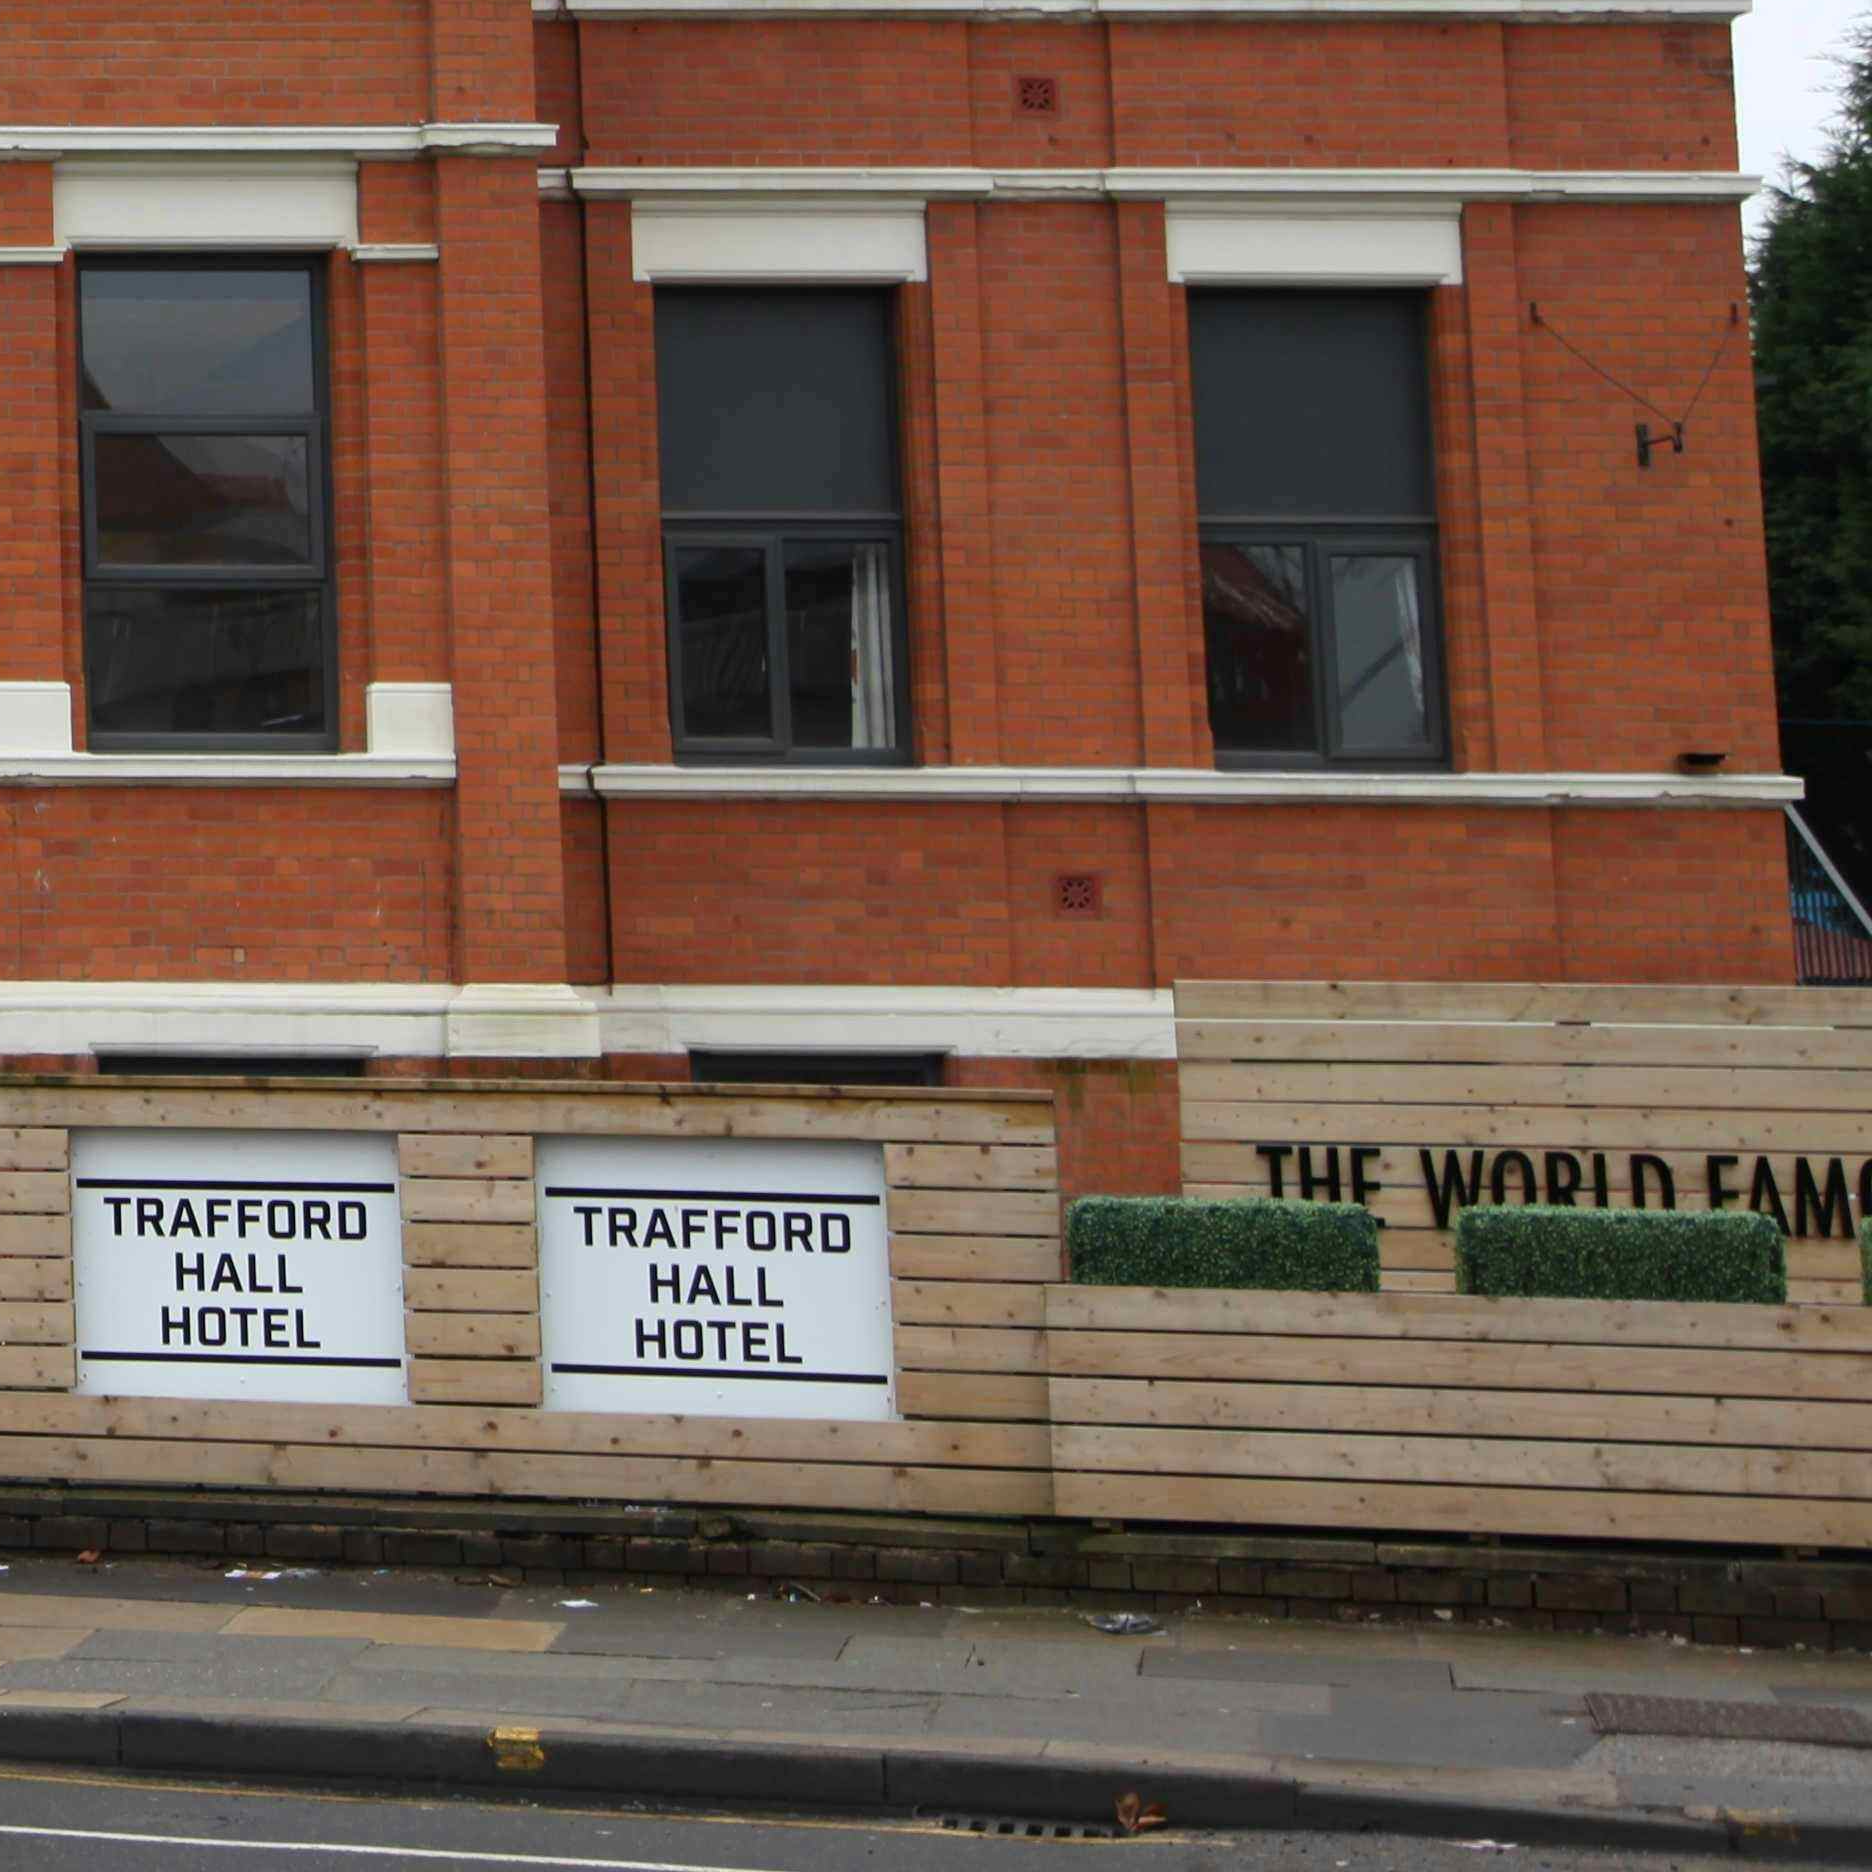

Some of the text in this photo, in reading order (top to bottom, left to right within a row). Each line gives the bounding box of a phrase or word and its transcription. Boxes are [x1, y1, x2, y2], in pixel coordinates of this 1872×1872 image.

[1256, 1146, 1385, 1227] THE
[1707, 1155, 1872, 1239] FAM
[103, 1197, 367, 1240] TRAFFORD
[573, 1206, 851, 1253] TRAFFORD
[175, 1252, 303, 1293] HALL
[649, 1263, 784, 1307] HALL
[161, 1306, 321, 1348] HOTEL
[635, 1318, 803, 1364] HOTEL
